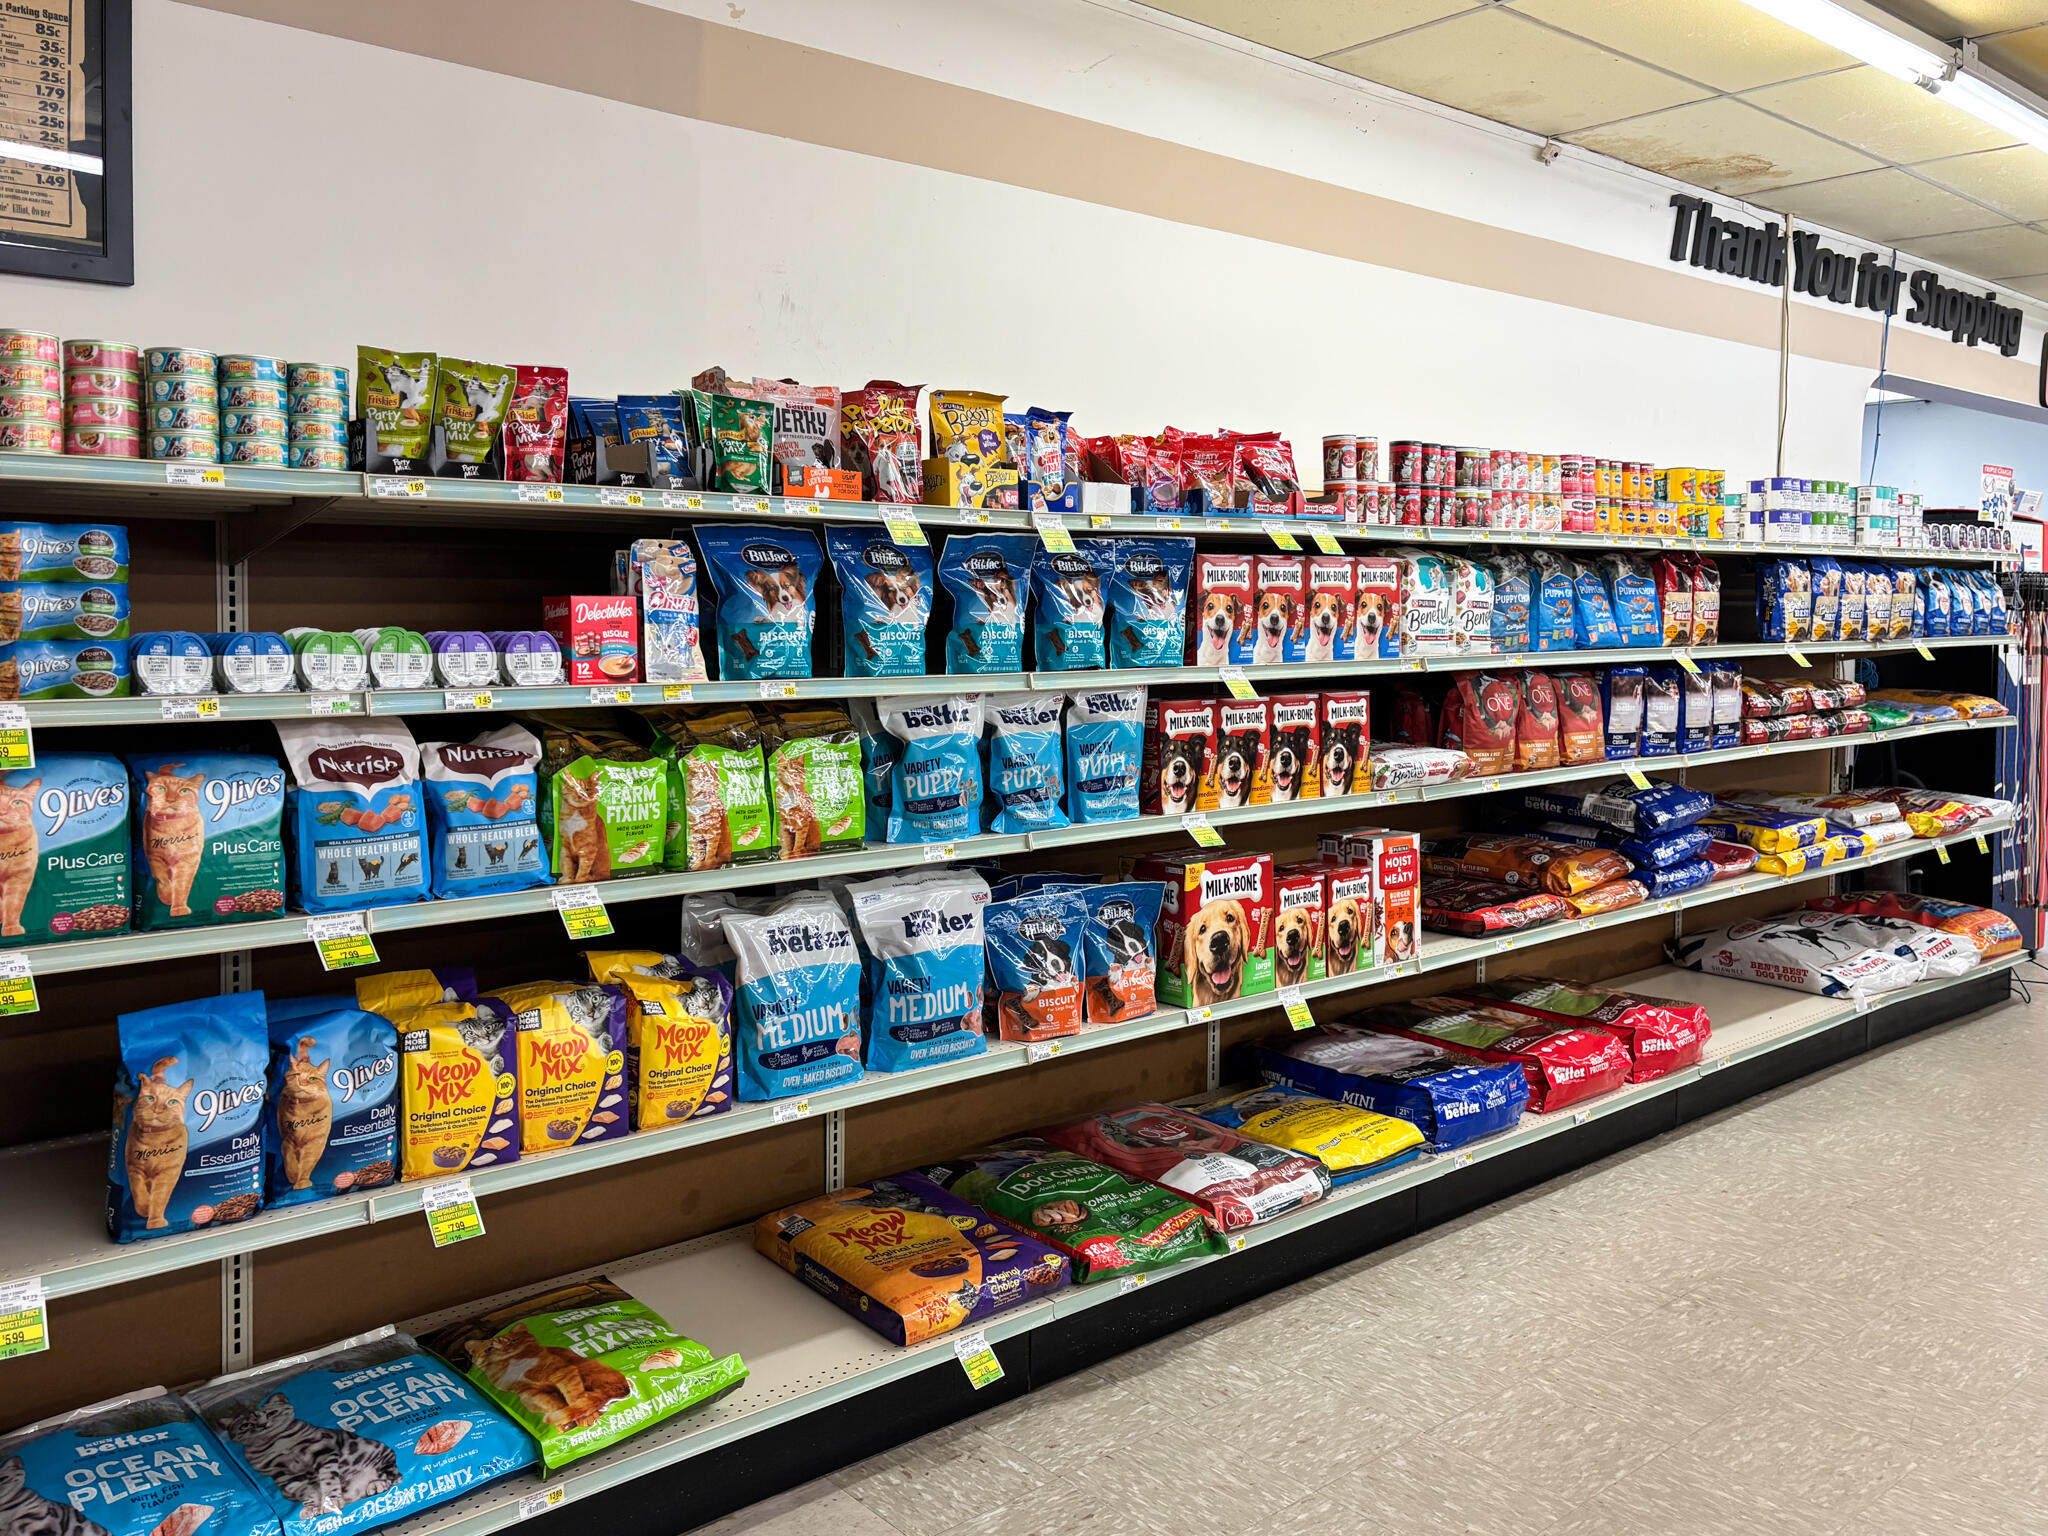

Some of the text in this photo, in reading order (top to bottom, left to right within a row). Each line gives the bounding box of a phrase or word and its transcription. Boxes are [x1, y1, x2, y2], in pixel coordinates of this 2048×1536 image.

[5, 2, 68, 23] Parking Space
[36, 84, 65, 99] 1.79
[36, 174, 65, 187] 1.49
[1670, 194, 2023, 356] Thank You for Shopping
[367, 393, 400, 407] Friskies
[366, 408, 401, 422] Party
[444, 404, 476, 419] Friskies
[508, 409, 537, 422] Friskies
[442, 417, 475, 433] Party
[510, 421, 540, 437] Party
[774, 408, 826, 436] JERKY
[446, 430, 471, 442] Mix
[719, 431, 745, 440] Friskies
[719, 440, 746, 451] Party
[724, 446, 744, 455] Mix
[1619, 586, 1639, 595] PUPPY
[576, 600, 633, 623] Delectables
[602, 630, 630, 639] BISQUE
[879, 631, 922, 641] BISCUITS
[981, 630, 1018, 641] BISCUITS
[1068, 629, 1101, 640] BISCUITS
[82, 650, 107, 659] Hearty
[576, 662, 589, 675] 12
[1531, 689, 1551, 703] ONE
[1569, 683, 1591, 697] ONE
[1486, 696, 1512, 712] ONE
[1079, 741, 1113, 755] VARIETY
[317, 756, 399, 775] Nutrish
[904, 758, 941, 774] VARIETY
[1080, 751, 1126, 779] PUPPY
[904, 767, 963, 798] PUPPY
[1002, 764, 1049, 792] PUPPY
[205, 773, 283, 823] 9Lives
[610, 784, 657, 802] FARM
[39, 781, 127, 836] 9Lives
[606, 801, 660, 824] FIXIN'S
[626, 829, 645, 837] FLAVOR
[631, 823, 653, 831] CHICKEN
[151, 835, 194, 848] Morris
[447, 829, 513, 844] WHOLE HEALTH
[212, 840, 281, 856] PlusCare
[318, 840, 418, 859] WHOLE HEALTH BLEND
[48, 851, 125, 871] PlusCare
[1385, 855, 1412, 868] MOIST
[1385, 871, 1413, 885] MEATY
[1390, 890, 1410, 899] BURGER
[1255, 960, 1271, 971] large
[1751, 961, 1809, 977] BEN'S BEST
[1755, 969, 1804, 984] DOG FOOD
[887, 976, 931, 994] VARIETY
[889, 982, 968, 1023] MEDIUM
[517, 1015, 540, 1025] MORE
[518, 1010, 540, 1020] NOW
[756, 1004, 844, 1050] MEDIUM
[404, 1036, 428, 1047] MORE
[405, 1030, 428, 1041] NOW
[656, 1021, 710, 1050] Meow
[404, 1042, 428, 1052] FLAVOR
[530, 1025, 590, 1067] Meow
[950, 1038, 976, 1053] BISCUITS
[416, 1048, 482, 1090] Meow
[648, 1063, 712, 1079] Original Choice
[1589, 1062, 1609, 1074] PROTEIN
[332, 1052, 395, 1103] 9Lives
[525, 1080, 597, 1097] Original Choice
[194, 1080, 265, 1133] 9Lives
[1342, 1091, 1375, 1109] MINI
[370, 1104, 396, 1121] Daily
[410, 1103, 486, 1122] Original Choice
[344, 1117, 396, 1137] Essentials
[232, 1133, 261, 1151] Daily
[200, 1146, 261, 1167] Essentials
[1199, 1155, 1219, 1168] LARGE
[1010, 1163, 1100, 1196] DOG CHOW
[1128, 1184, 1158, 1199] ADULT
[1174, 1209, 1200, 1229] VALUE
[1226, 1209, 1252, 1228] ONE
[855, 1226, 914, 1253] MIX
[985, 1266, 1019, 1286] Original
[991, 1278, 1020, 1294] Choice
[332, 1359, 416, 1390] better
[329, 1374, 446, 1420] OCEAN
[334, 1388, 469, 1434] PLENTY
[395, 1405, 444, 1425] WITH FISH
[404, 1412, 442, 1427] FLAVOR
[76, 1430, 170, 1459] better
[63, 1444, 210, 1488] OCEAN
[67, 1461, 222, 1513] PLENTY
[128, 1483, 186, 1504] WITH FISH
[139, 1490, 186, 1510] FLAVOR
